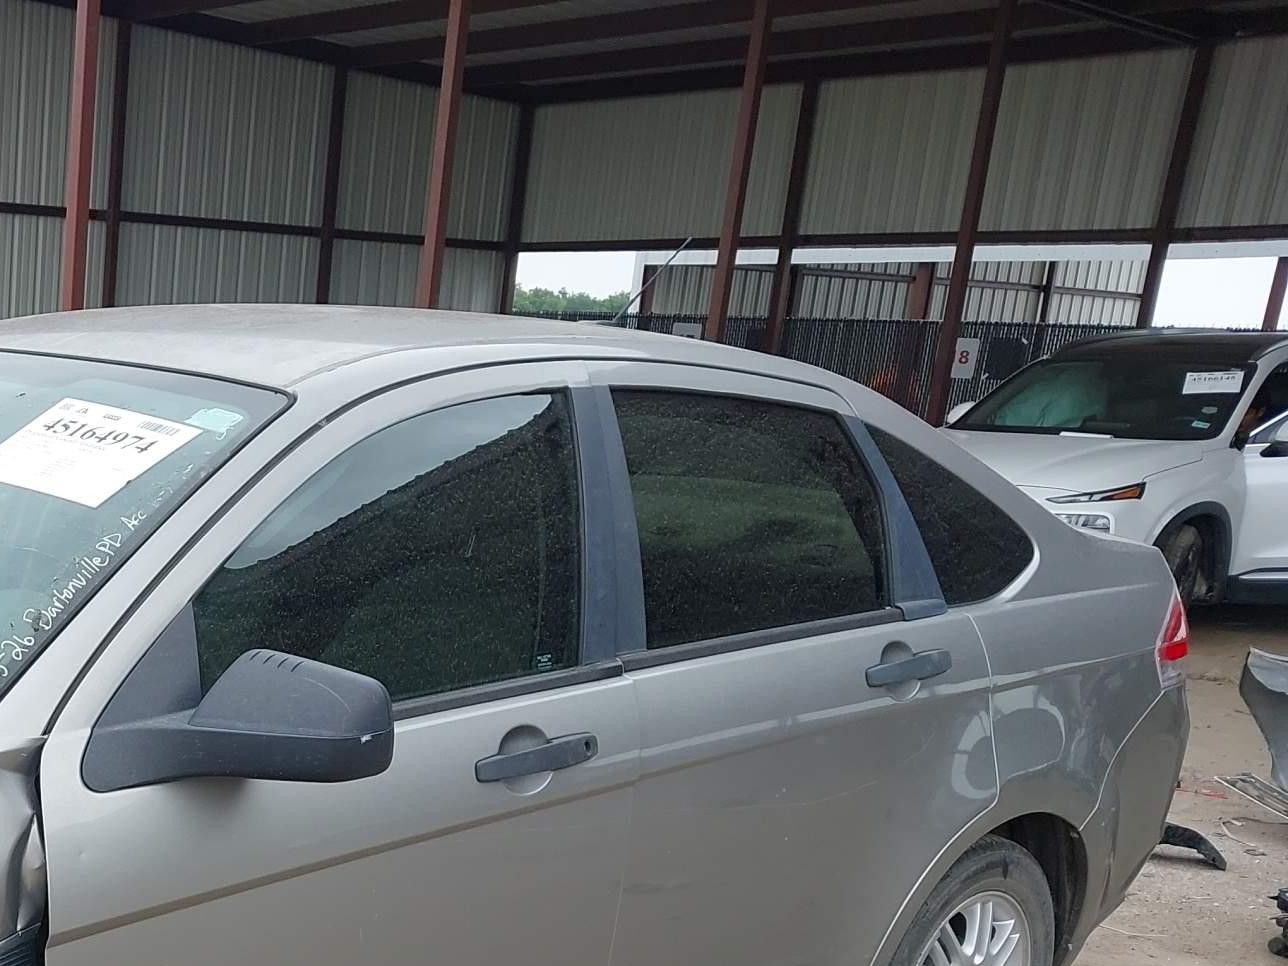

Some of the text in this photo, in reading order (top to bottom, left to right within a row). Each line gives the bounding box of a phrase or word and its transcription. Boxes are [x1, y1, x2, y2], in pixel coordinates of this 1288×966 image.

[959, 350, 970, 364] 8
[43, 418, 159, 453] 45164974
[95, 533, 122, 556] PD
